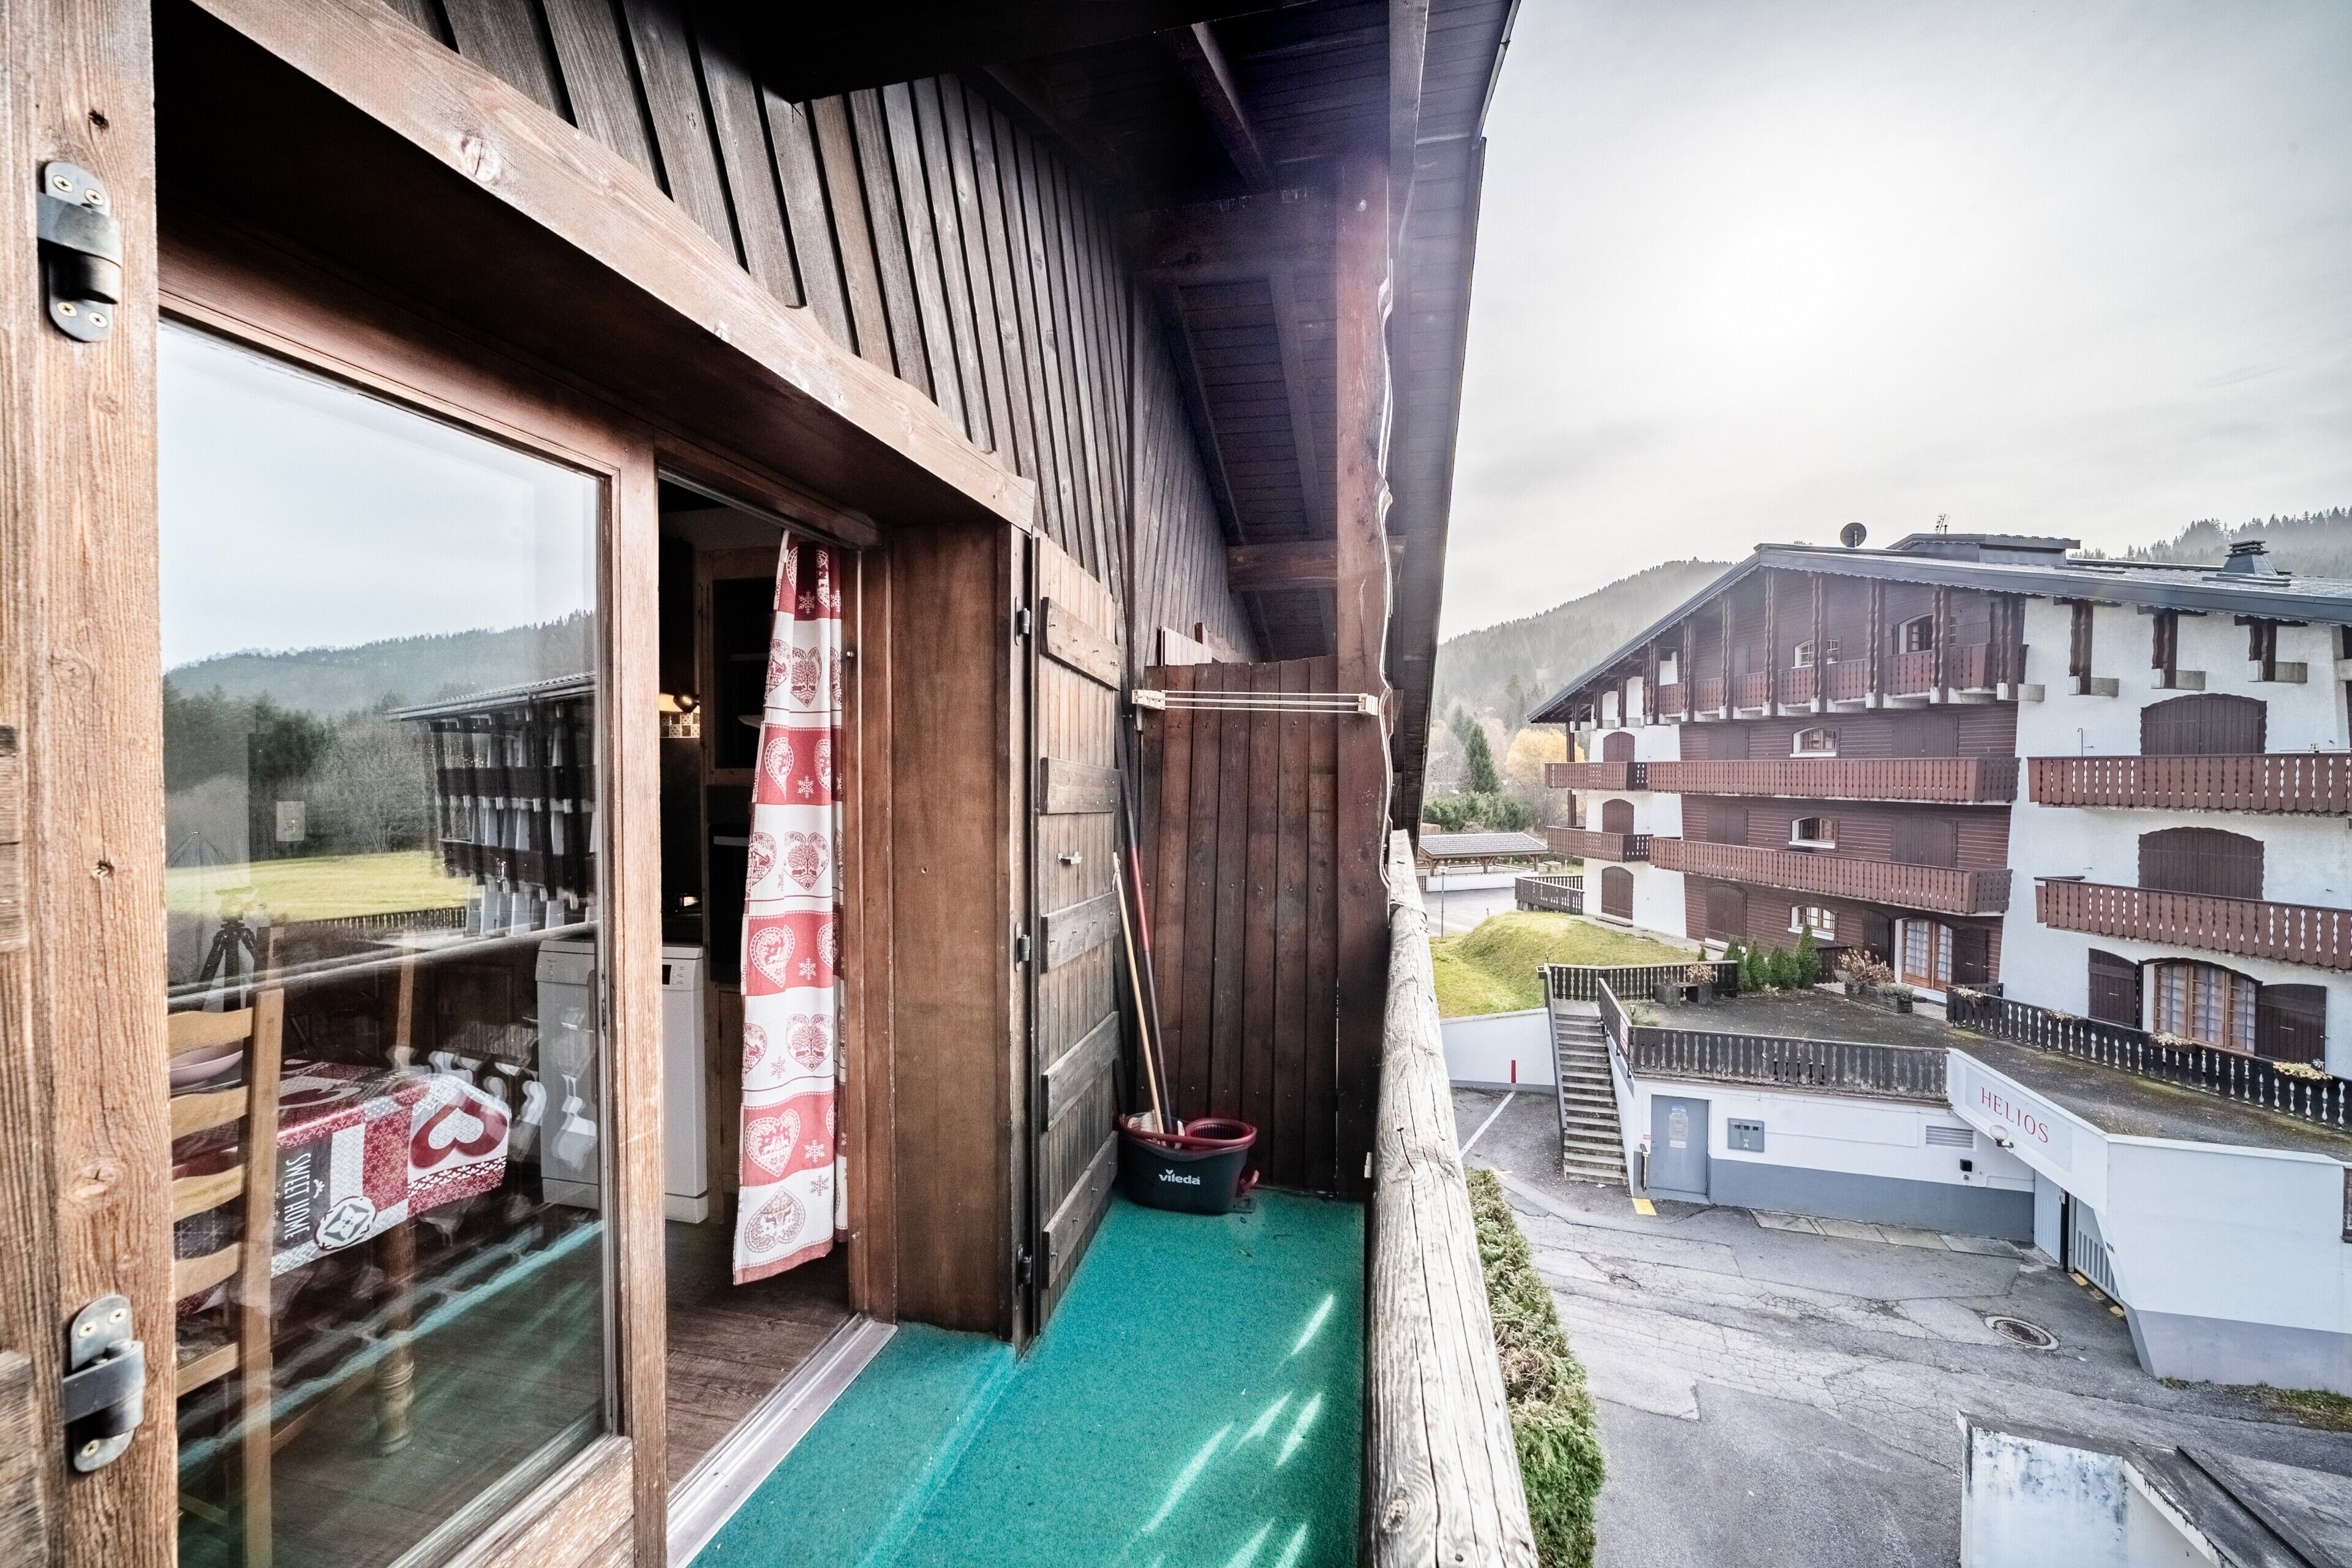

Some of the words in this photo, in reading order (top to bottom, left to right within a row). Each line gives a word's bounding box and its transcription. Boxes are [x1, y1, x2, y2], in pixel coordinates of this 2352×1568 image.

[1980, 1086, 2049, 1144] HELIOS
[284, 1152, 312, 1200] SWEET
[1158, 1169, 1200, 1185] vileda
[284, 1198, 311, 1241] HOME
